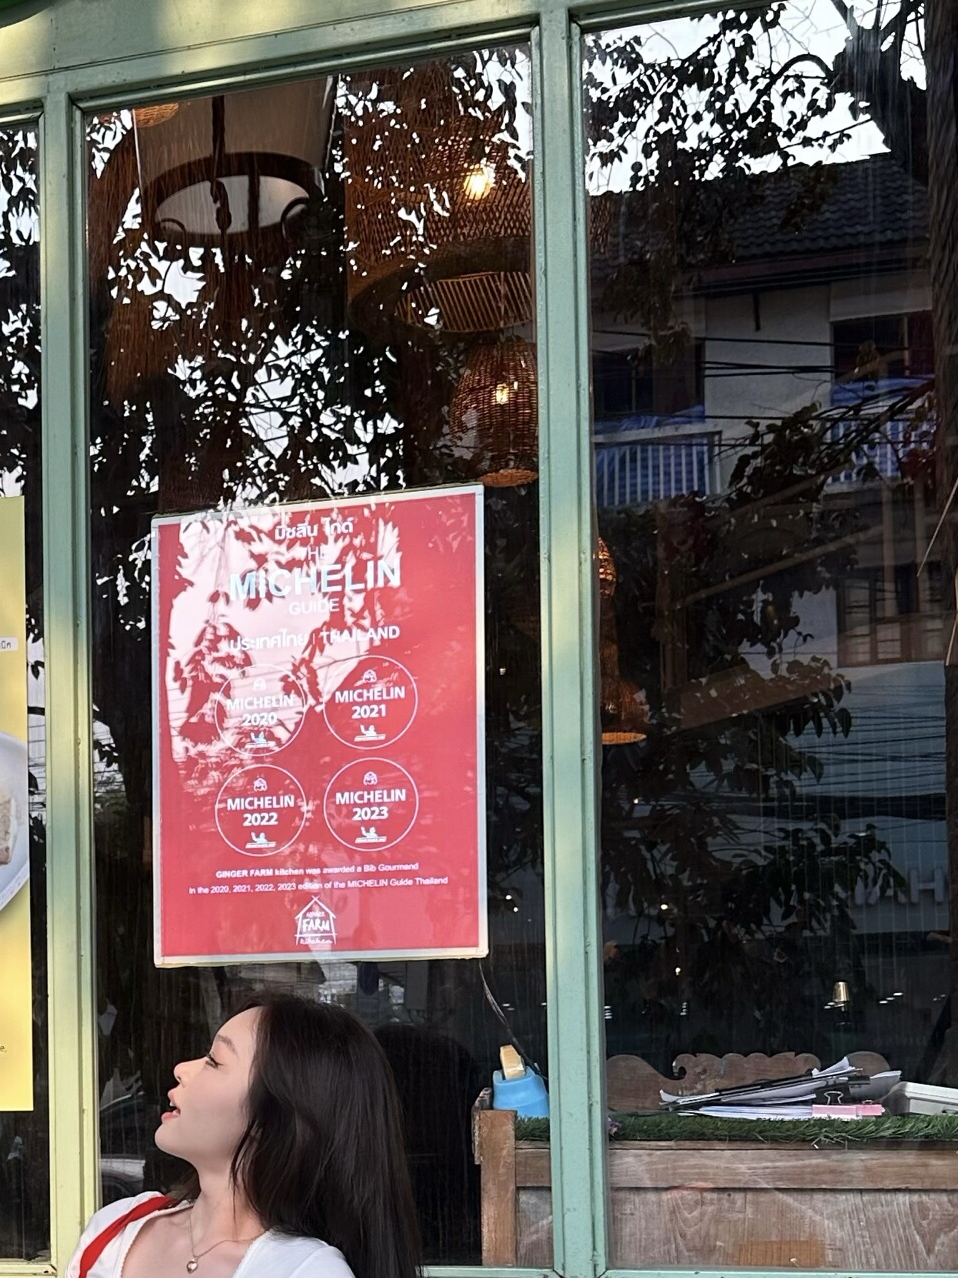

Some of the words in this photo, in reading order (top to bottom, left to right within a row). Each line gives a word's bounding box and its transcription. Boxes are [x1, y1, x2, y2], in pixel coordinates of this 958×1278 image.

[230, 559, 402, 600] MICHELIN
[289, 598, 340, 615] GUIDE
[320, 626, 401, 644] THAILAND
[335, 686, 406, 703] MICHELIN
[226, 695, 294, 711] MICHELIN
[242, 712, 278, 726] 2020
[352, 704, 386, 719] 2021
[227, 795, 295, 811] MICHELIN
[336, 789, 406, 805] MICHELIN
[243, 812, 278, 827] 2022
[352, 806, 389, 821] 2023
[216, 870, 248, 878] GINGER
[250, 868, 273, 877] FARM
[275, 867, 304, 876] kitchen
[322, 865, 354, 874] awarded
[364, 864, 376, 872] Bib
[378, 862, 419, 872] Gourmand
[278, 882, 296, 891] 2023
[324, 881, 332, 889] of
[348, 879, 388, 888] MICHELIN
[390, 878, 413, 886] Guide
[414, 876, 448, 886] Thailand
[302, 918, 330, 932] FARM
